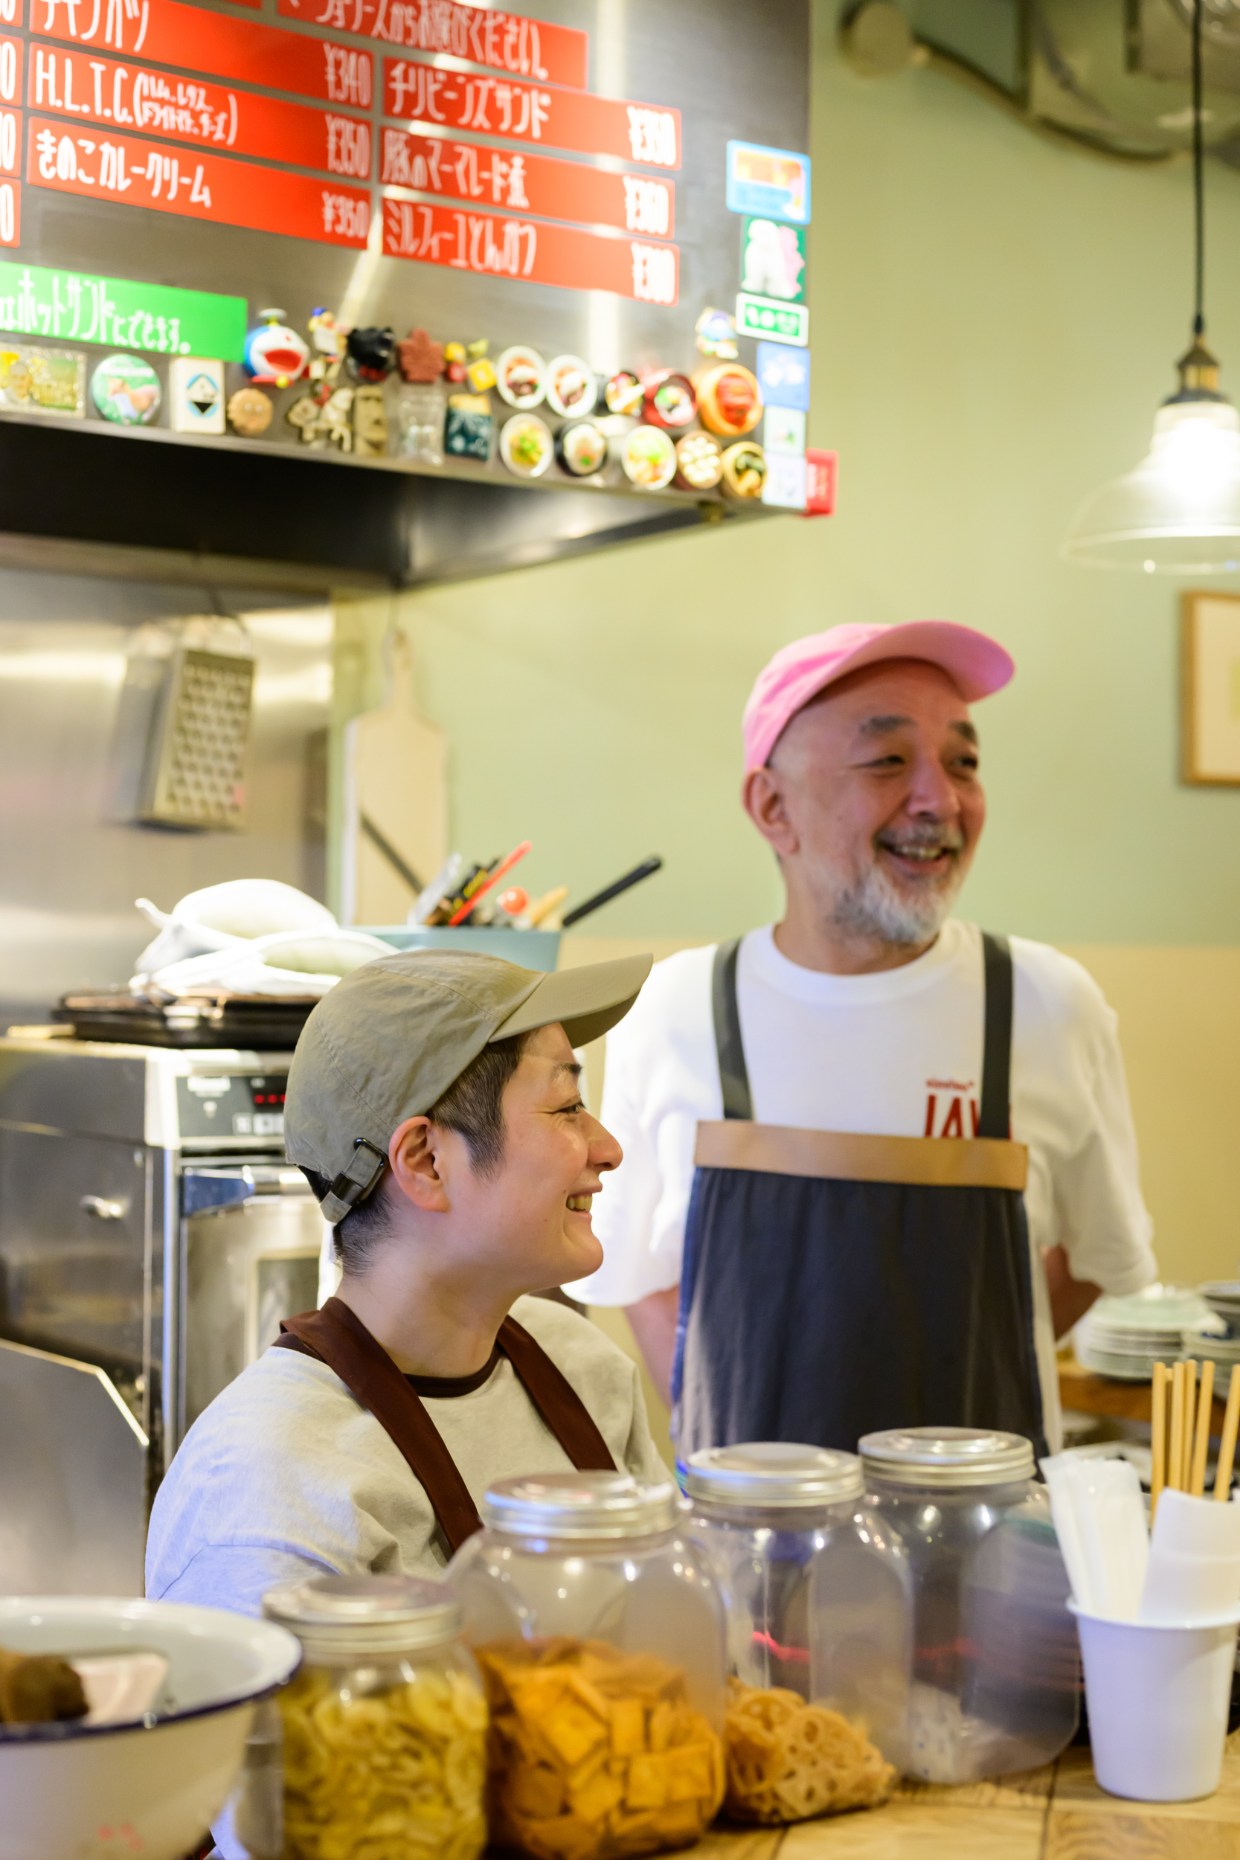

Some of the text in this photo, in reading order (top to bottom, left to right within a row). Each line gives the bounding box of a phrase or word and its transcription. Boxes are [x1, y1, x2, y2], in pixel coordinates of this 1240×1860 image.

[36, 128, 212, 208] きのこカレークリーム
